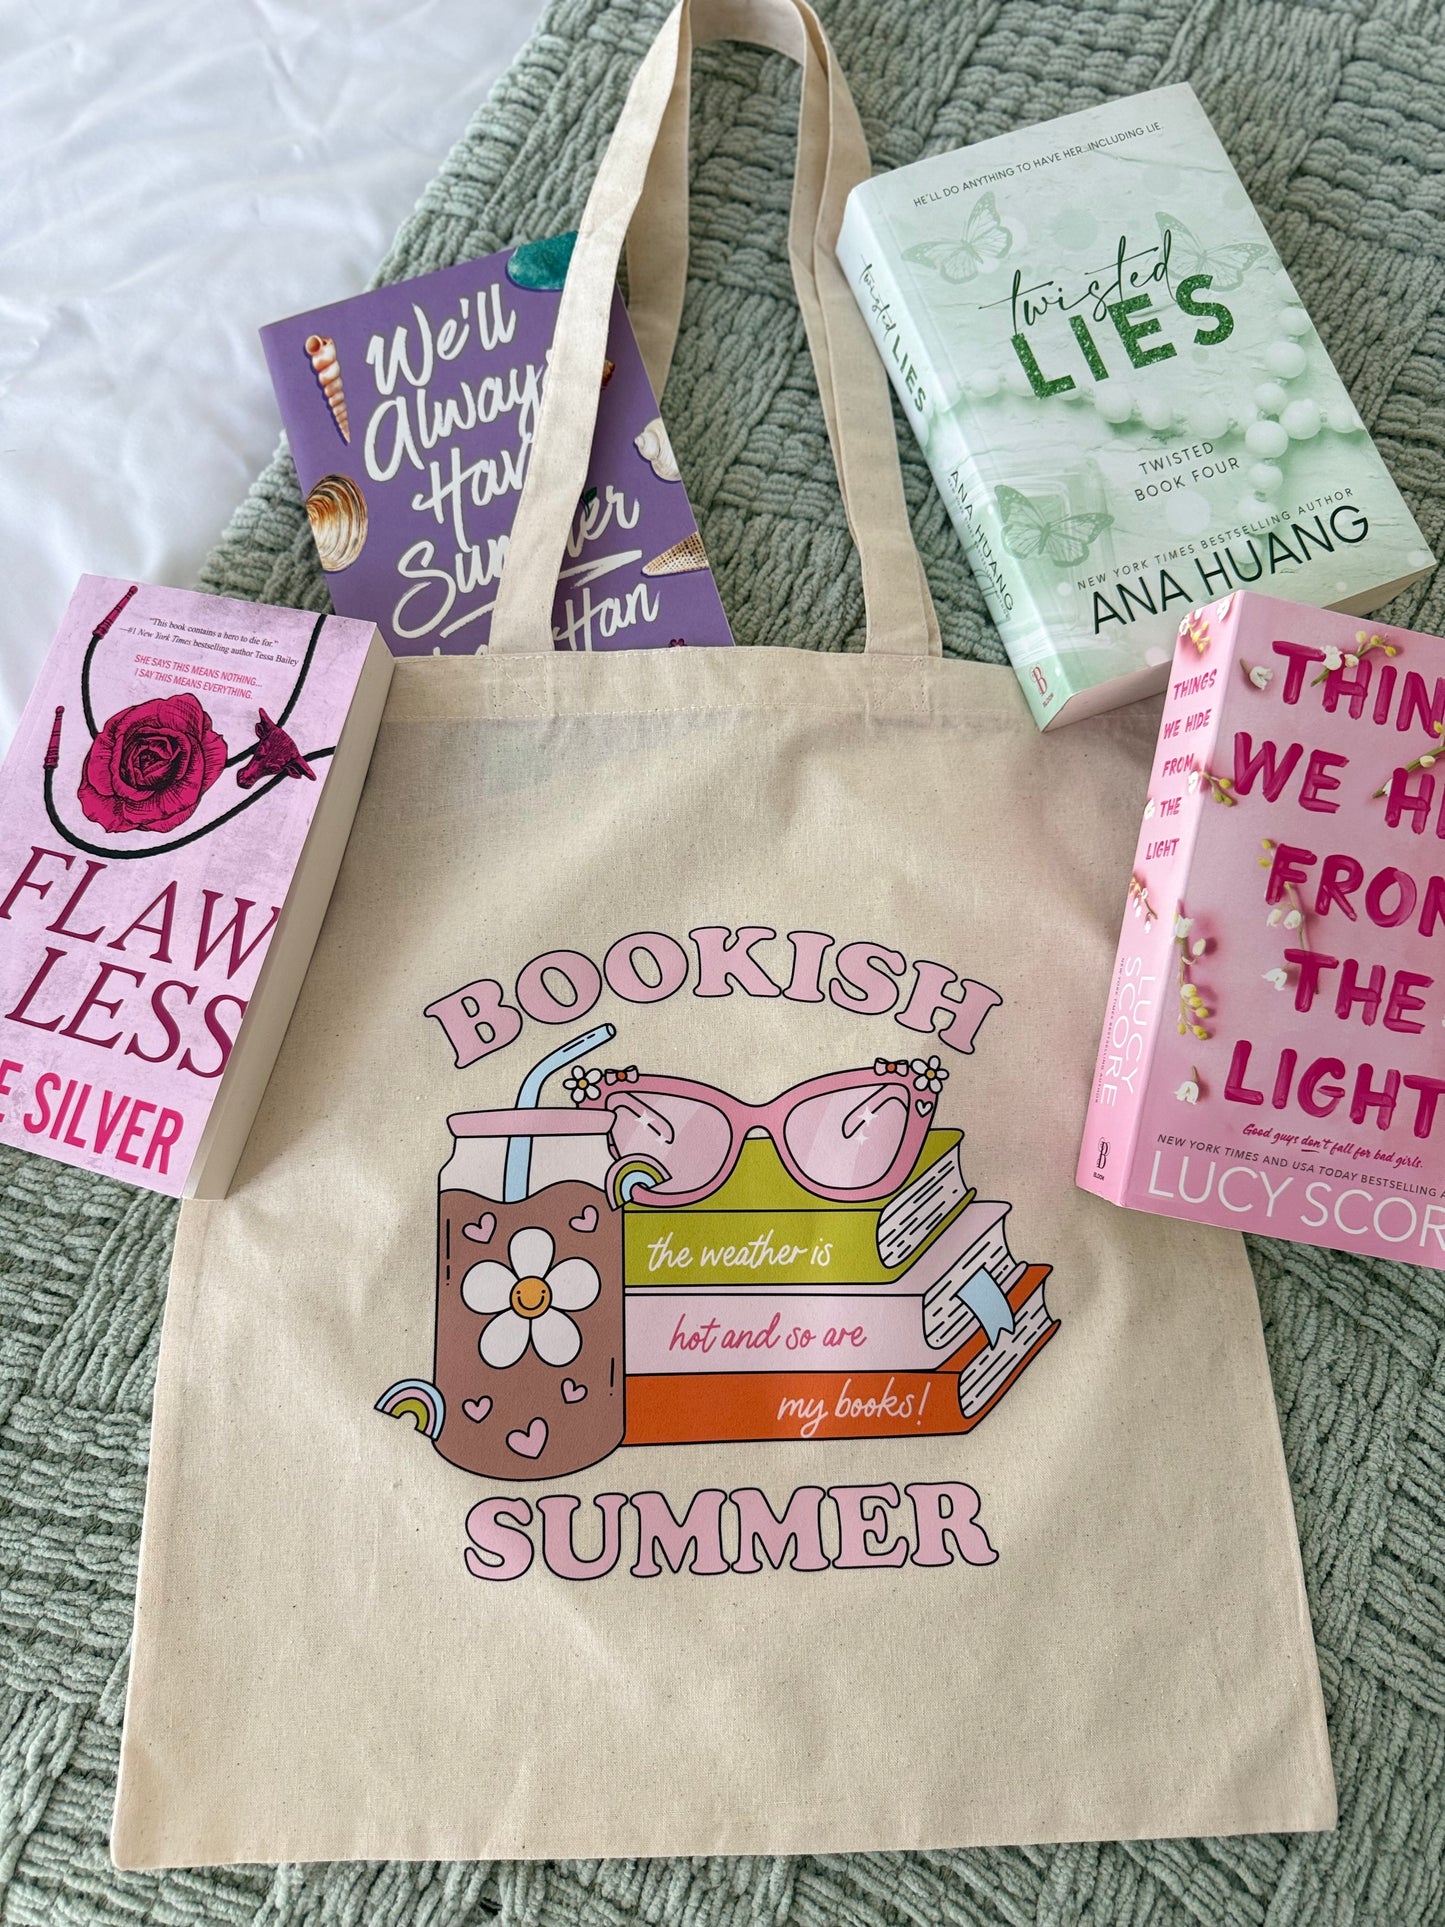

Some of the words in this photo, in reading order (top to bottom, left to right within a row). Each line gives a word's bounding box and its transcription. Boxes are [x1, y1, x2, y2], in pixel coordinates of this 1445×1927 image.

[913, 190, 942, 207] HE'LL
[943, 185, 960, 197] DO
[962, 167, 1015, 191] ANYTHING
[1016, 162, 1031, 173] TO
[1033, 152, 1062, 168] HAVE
[979, 229, 1177, 334] twisted
[366, 283, 517, 395] We'll
[892, 334, 927, 412] LIES
[1010, 274, 1235, 399] LIES
[364, 349, 552, 481] Alway
[412, 440, 531, 552] Hav
[1135, 476, 1186, 501] BOOK
[1192, 457, 1240, 482] FOUR
[1139, 442, 1214, 475] TWISTED
[392, 485, 641, 638] Suer
[951, 470, 973, 520] ANA
[975, 524, 1014, 611] HUANG
[1077, 573, 1107, 590] NEW
[1113, 560, 1149, 578] YORK
[1154, 544, 1195, 565] TIMES
[1201, 511, 1291, 549] BESTSELLING
[1298, 488, 1353, 515] AUTHOR
[1093, 569, 1193, 634] ANA
[1194, 505, 1369, 596] HUANG
[137, 629, 153, 638] New
[154, 632, 171, 642] York
[171, 635, 192, 646] Times
[193, 639, 230, 654] bestselling
[231, 647, 254, 658] author
[254, 651, 274, 662] Tessa
[275, 654, 299, 667] Bailey
[169, 621, 186, 631] book
[187, 626, 217, 637] contains
[223, 631, 239, 642] hero
[249, 636, 261, 646] die
[553, 583, 660, 651] Han
[134, 654, 152, 665] SHE
[151, 657, 171, 669] SAYS
[173, 661, 190, 673] THIS
[191, 665, 220, 680] MEANS
[134, 668, 139, 676] I
[139, 669, 155, 680] SAY
[155, 672, 172, 683] THIS
[173, 675, 201, 690] MEANS
[203, 681, 253, 700] EVERYTHING.
[1173, 668, 1218, 701] THINGS
[1272, 640, 1445, 738] THIN
[1162, 753, 1195, 778] FROM
[1164, 719, 1181, 740] WE
[1185, 709, 1212, 734] HIDE
[1160, 797, 1182, 818] THE
[1234, 731, 1349, 814] WE
[1145, 838, 1180, 861] LIGHT
[0, 845, 281, 980] FLAW
[5, 946, 249, 1079] LESS
[423, 925, 1003, 1070] BOOKISH
[1100, 956, 1142, 1107] SCORE
[1283, 948, 1434, 1034] THE
[1121, 976, 1156, 1094] LUCY
[23, 1072, 184, 1175] SILVER
[1224, 1039, 1445, 1139] LIGHT
[1157, 1133, 1186, 1147] NEW
[1189, 1140, 1220, 1154] YORK
[1224, 1147, 1258, 1162] TIMES
[1262, 1155, 1288, 1167] AND
[1292, 1161, 1315, 1173] USA
[1318, 1166, 1358, 1181] TODAY
[1360, 1174, 1437, 1197] BESTSELLING
[1243, 1123, 1272, 1138] Good
[1273, 1131, 1300, 1145] guys
[1301, 1135, 1331, 1150] don't
[1329, 1141, 1354, 1155] fall
[1353, 1147, 1371, 1160] for
[1374, 1149, 1396, 1162] bad
[1393, 1156, 1423, 1169] girls.
[1148, 1150, 1294, 1218] LUCY
[1300, 1181, 1445, 1253] SCOR
[647, 1231, 693, 1271] the
[700, 1229, 808, 1269] weather
[810, 1238, 833, 1267] is
[669, 1313, 721, 1353] hot
[721, 1312, 781, 1349] and
[786, 1326, 816, 1350] so
[823, 1326, 867, 1347] are
[777, 1395, 829, 1438] my
[835, 1376, 931, 1426] books!
[464, 1481, 1000, 1581] SUMMER
